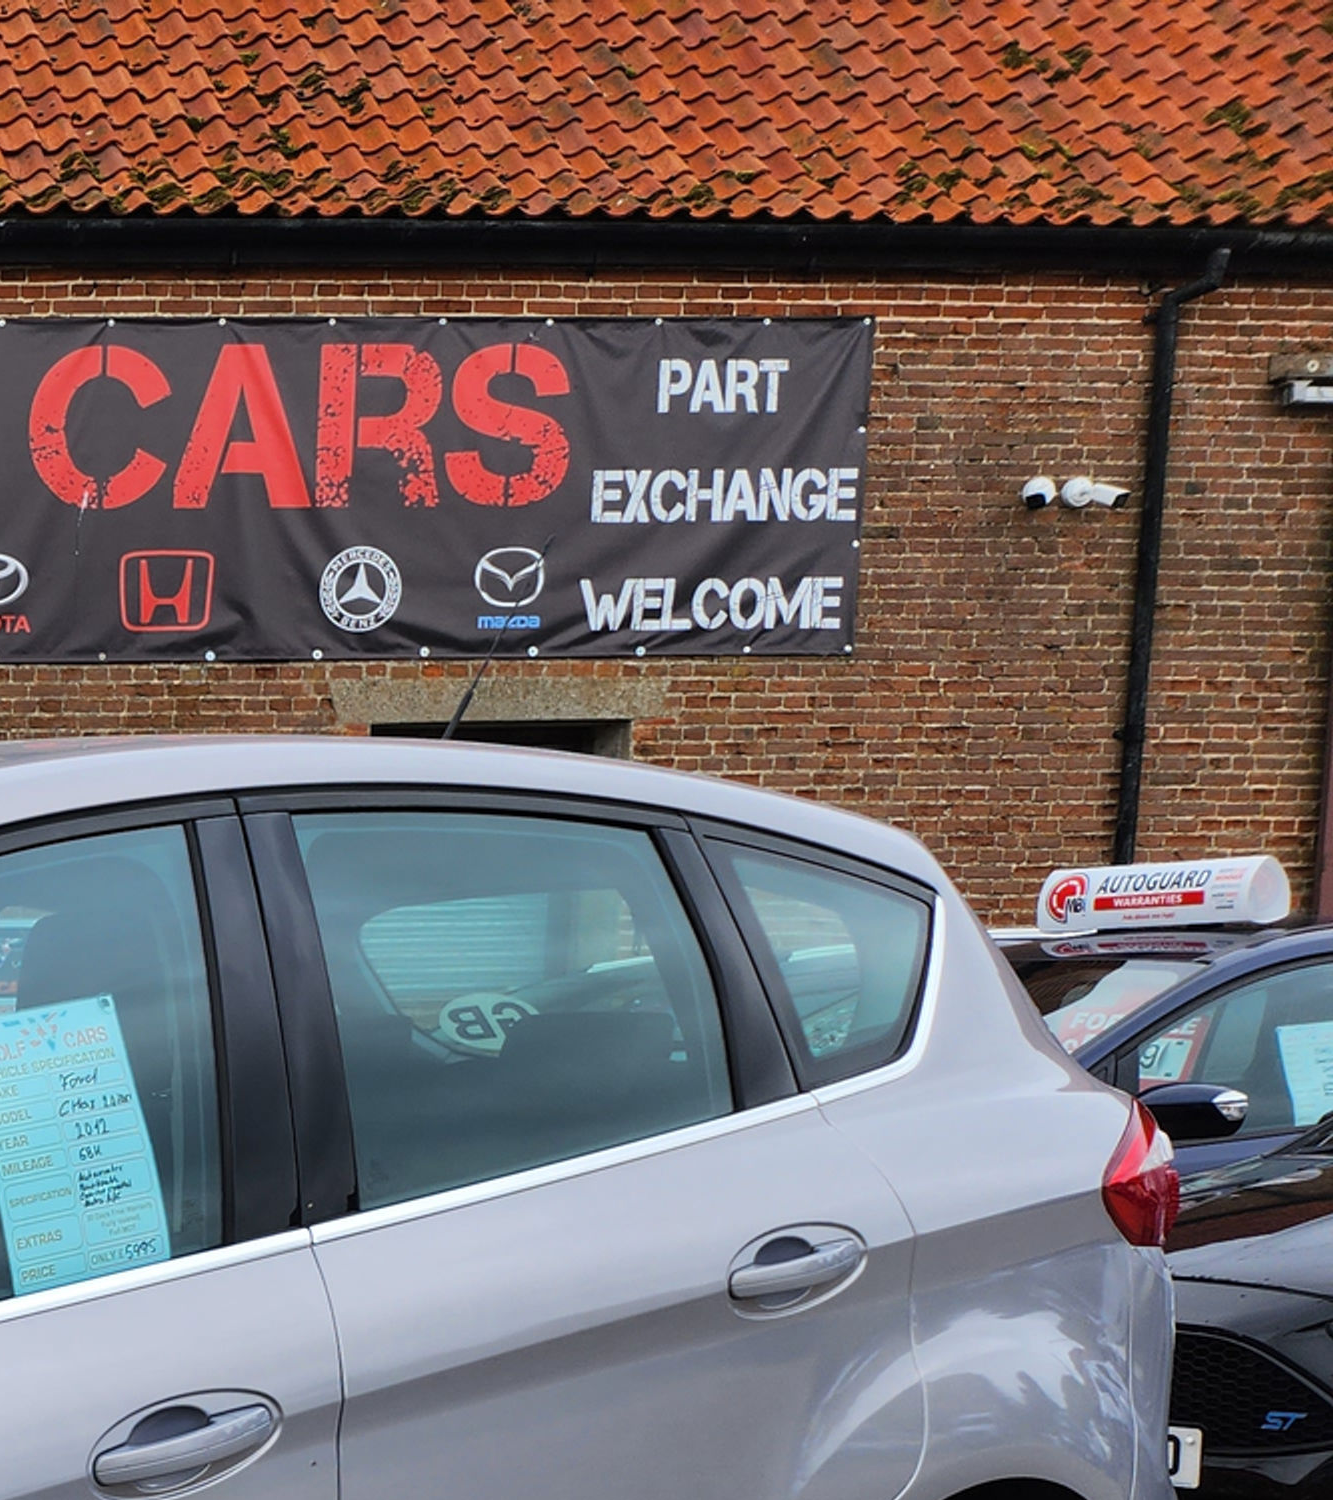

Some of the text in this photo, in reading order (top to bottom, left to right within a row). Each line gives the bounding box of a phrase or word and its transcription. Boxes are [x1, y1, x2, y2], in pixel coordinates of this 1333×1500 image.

[657, 358, 790, 413] PART
[28, 344, 570, 510] CARS
[590, 468, 859, 524] EXCHANGE
[579, 577, 844, 632] WELCOME
[1096, 869, 1212, 895] AUTOGUARD
[1113, 894, 1183, 908] WARRANTIES
[62, 1026, 109, 1048] CARS
[31, 1047, 116, 1073] SPECIFICATION
[1, 1154, 54, 1176] MILEAGE
[16, 1229, 63, 1250] EXTRAS
[20, 1264, 56, 1282] PRICE
[1261, 1411, 1309, 1430] ST
